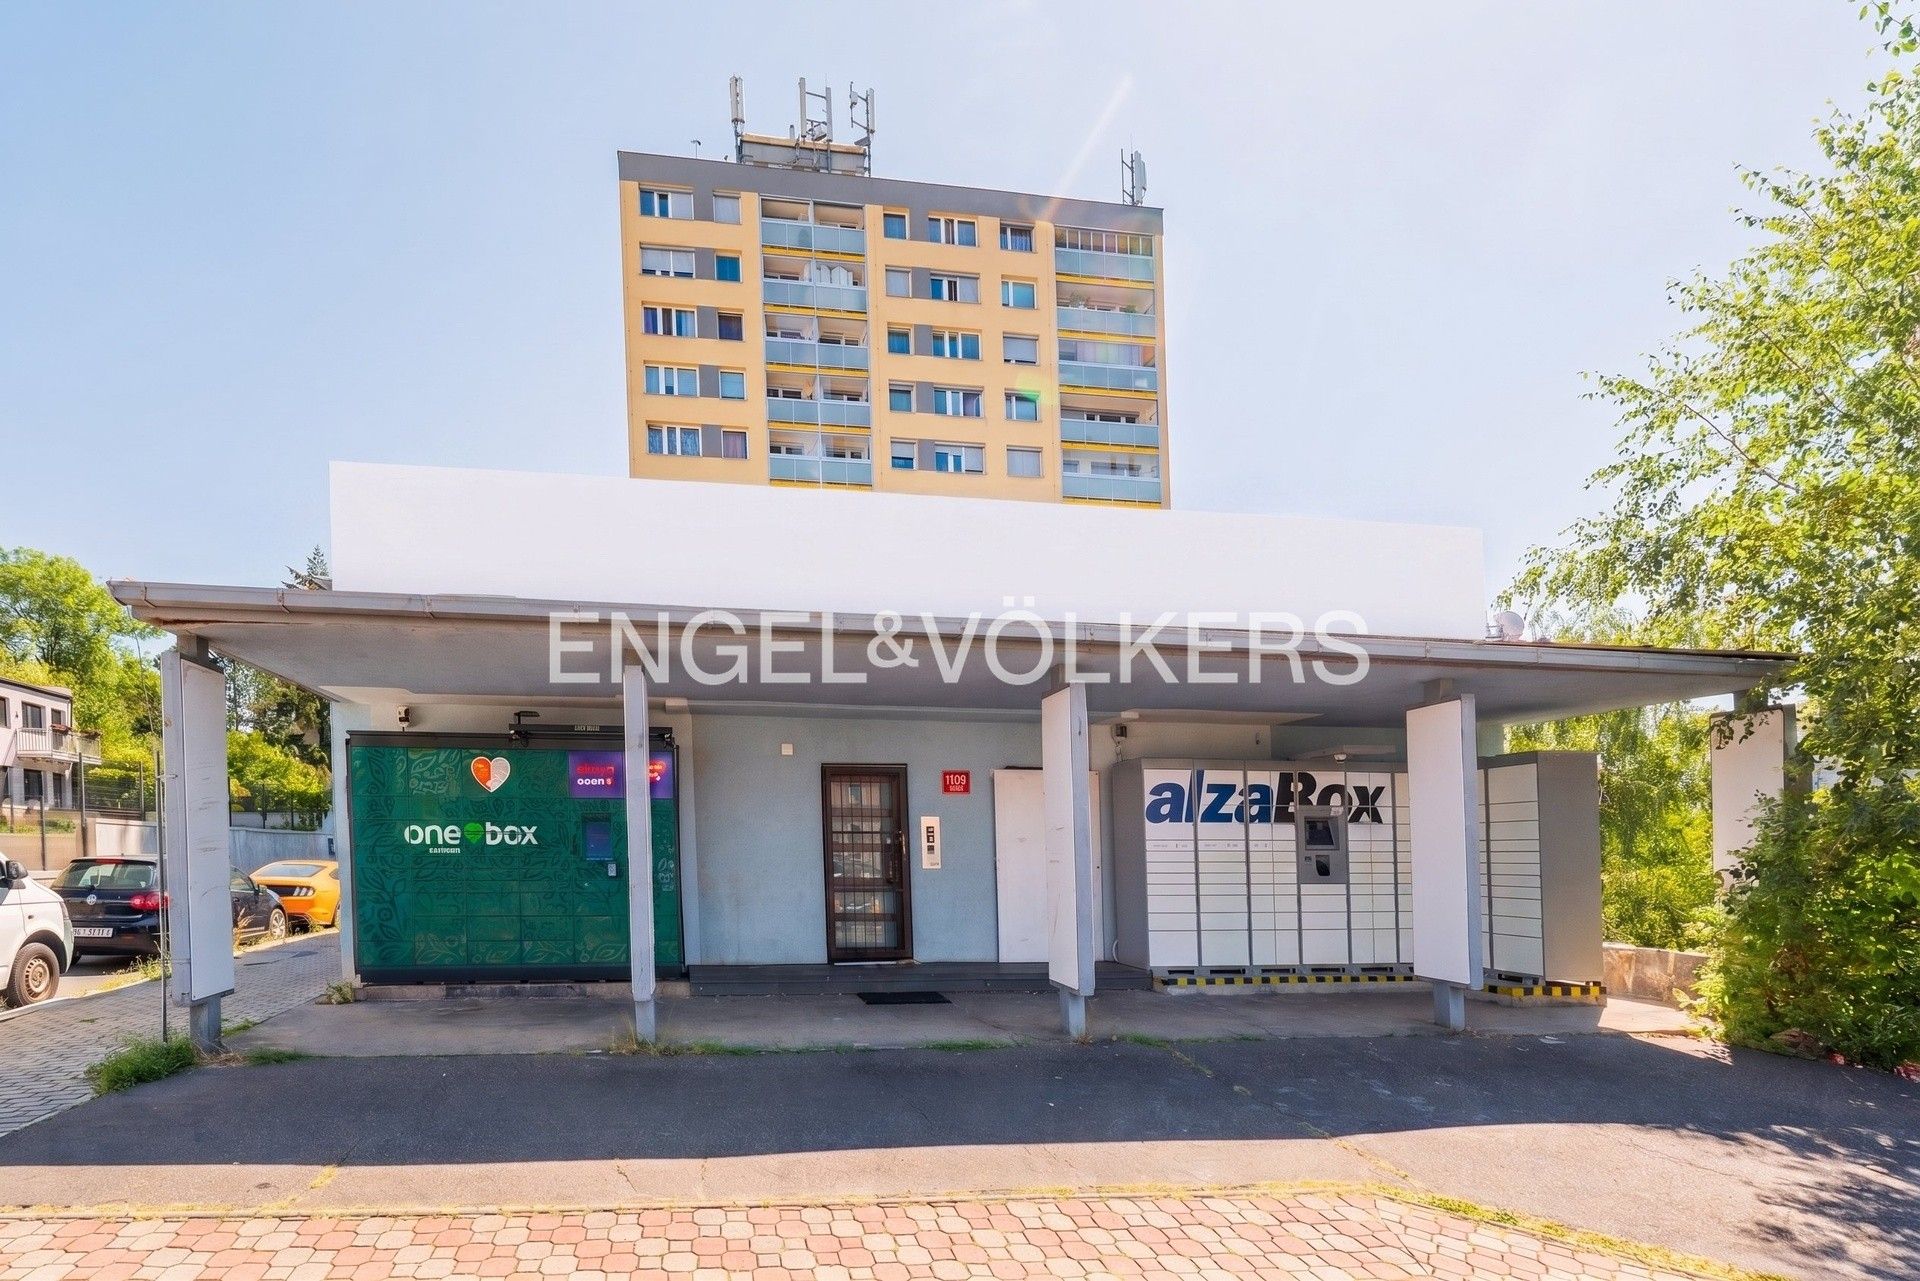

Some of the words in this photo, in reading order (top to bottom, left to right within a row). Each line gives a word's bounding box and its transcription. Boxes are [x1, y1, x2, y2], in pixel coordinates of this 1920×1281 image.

[945, 774, 967, 785] 1109
[1145, 769, 1386, 824] alzaBox
[403, 824, 462, 845] one
[485, 821, 539, 846] box
